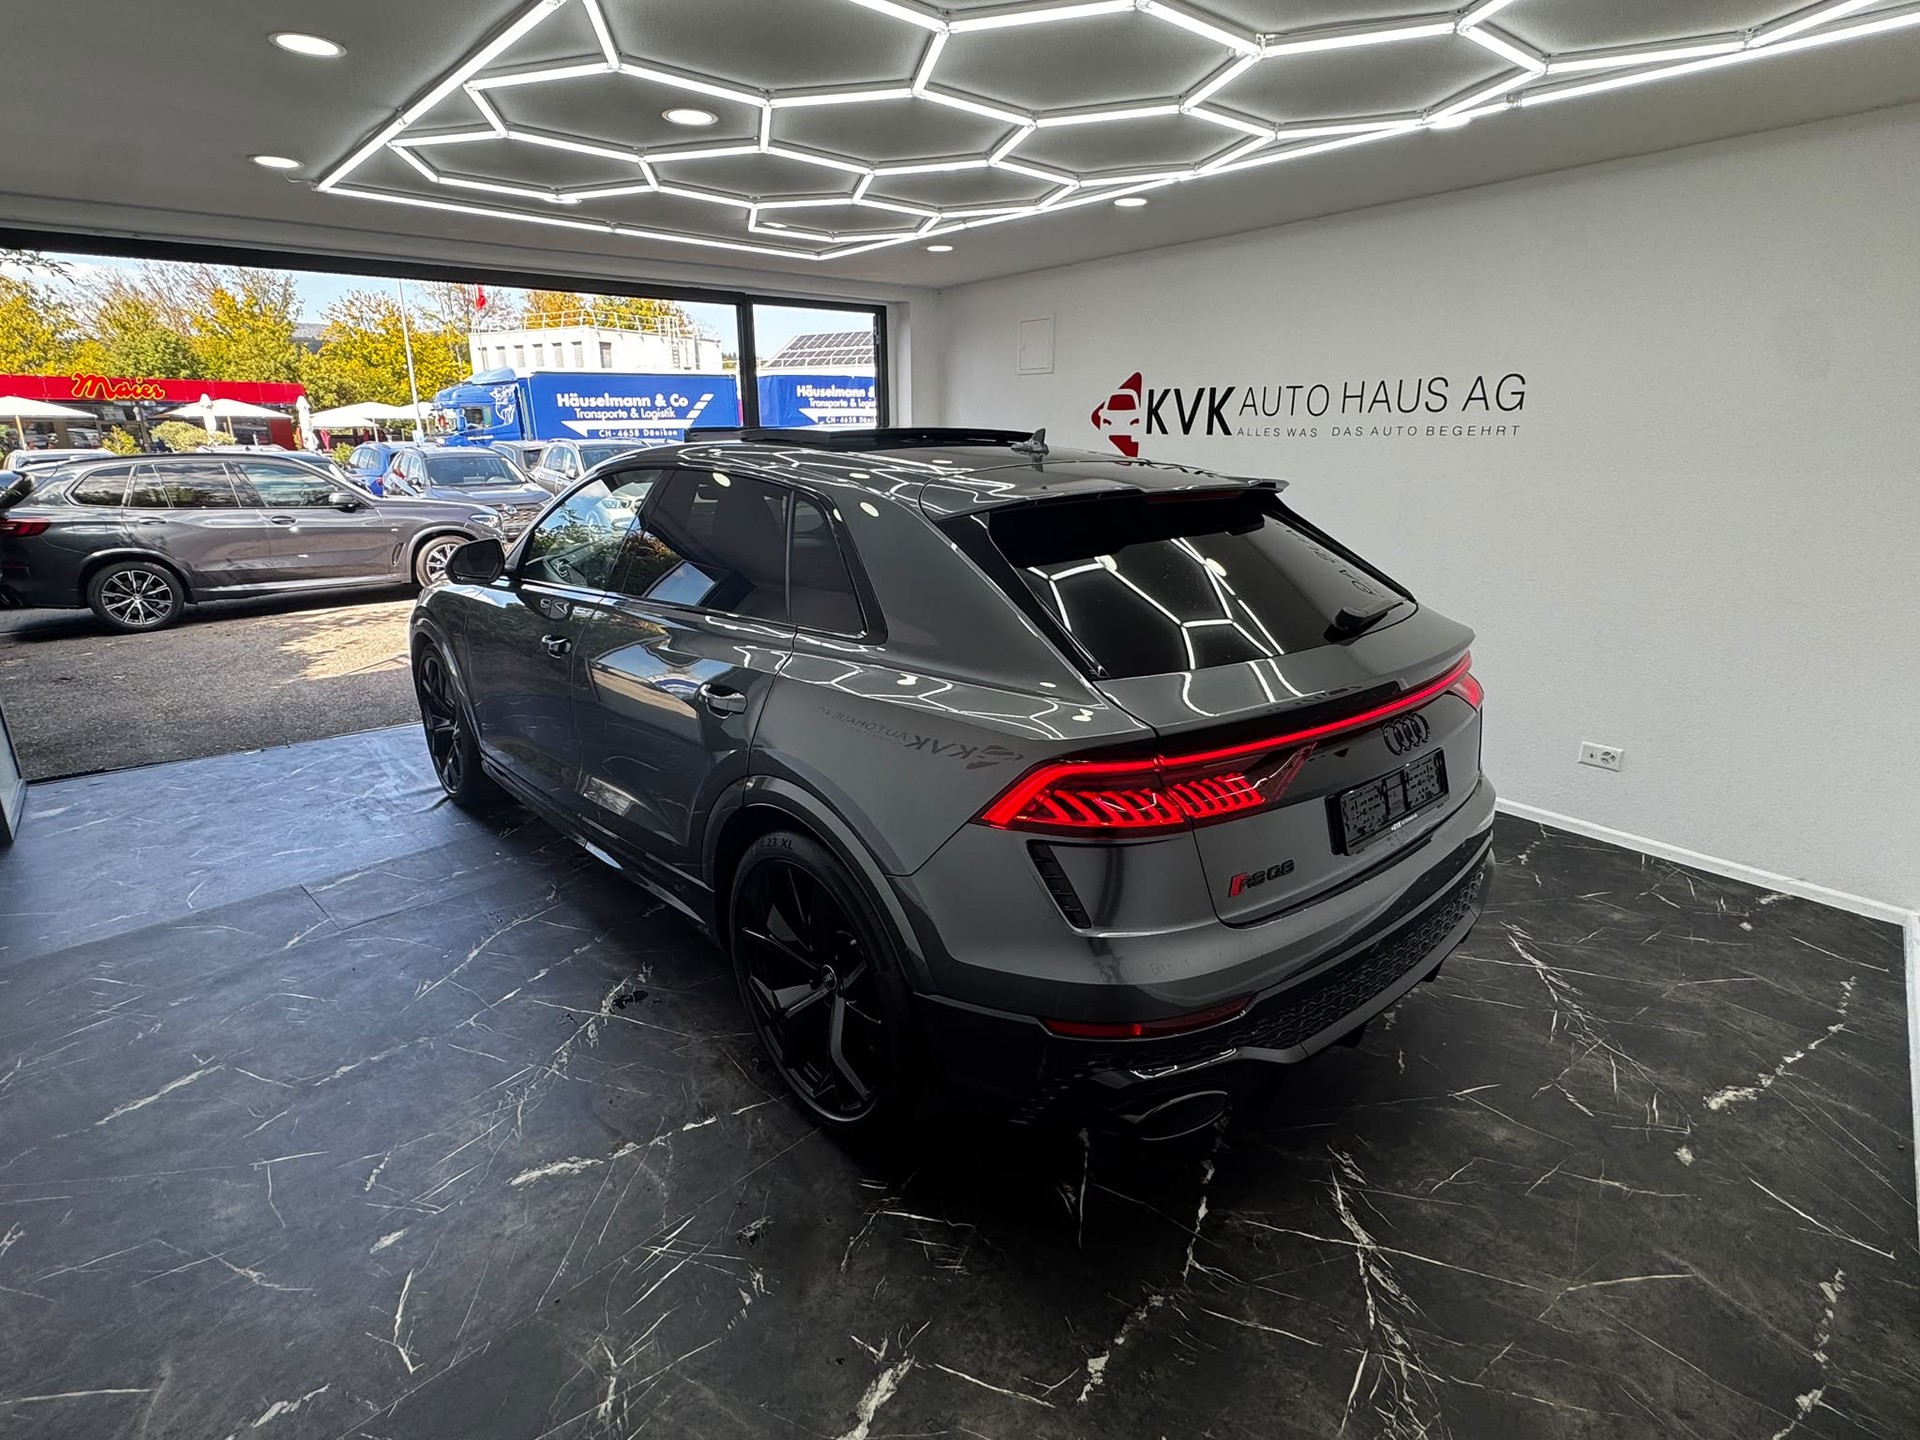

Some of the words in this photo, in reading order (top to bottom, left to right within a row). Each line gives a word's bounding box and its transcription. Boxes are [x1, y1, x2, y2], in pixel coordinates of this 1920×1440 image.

[71, 371, 165, 401] Maier
[797, 385, 865, 397] Häuselmann
[557, 393, 651, 407] Häuselmann
[655, 393, 666, 407] &
[669, 393, 689, 407] Co
[809, 398, 848, 409] Transporte
[850, 398, 857, 407] &
[1146, 387, 1235, 436] KVK
[1239, 384, 1330, 417] AUTO
[1341, 376, 1449, 414] HAUS
[1461, 373, 1526, 412] AG
[575, 408, 628, 420] Transporte
[630, 408, 639, 418] &
[641, 407, 676, 420] Logistik
[1236, 427, 1281, 438] ALLES
[1286, 427, 1318, 438] WAS
[1331, 426, 1363, 437] DAS
[1369, 425, 1418, 437] AUTO
[1425, 424, 1521, 437] BEGEHRT
[781, 838, 793, 850] XL
